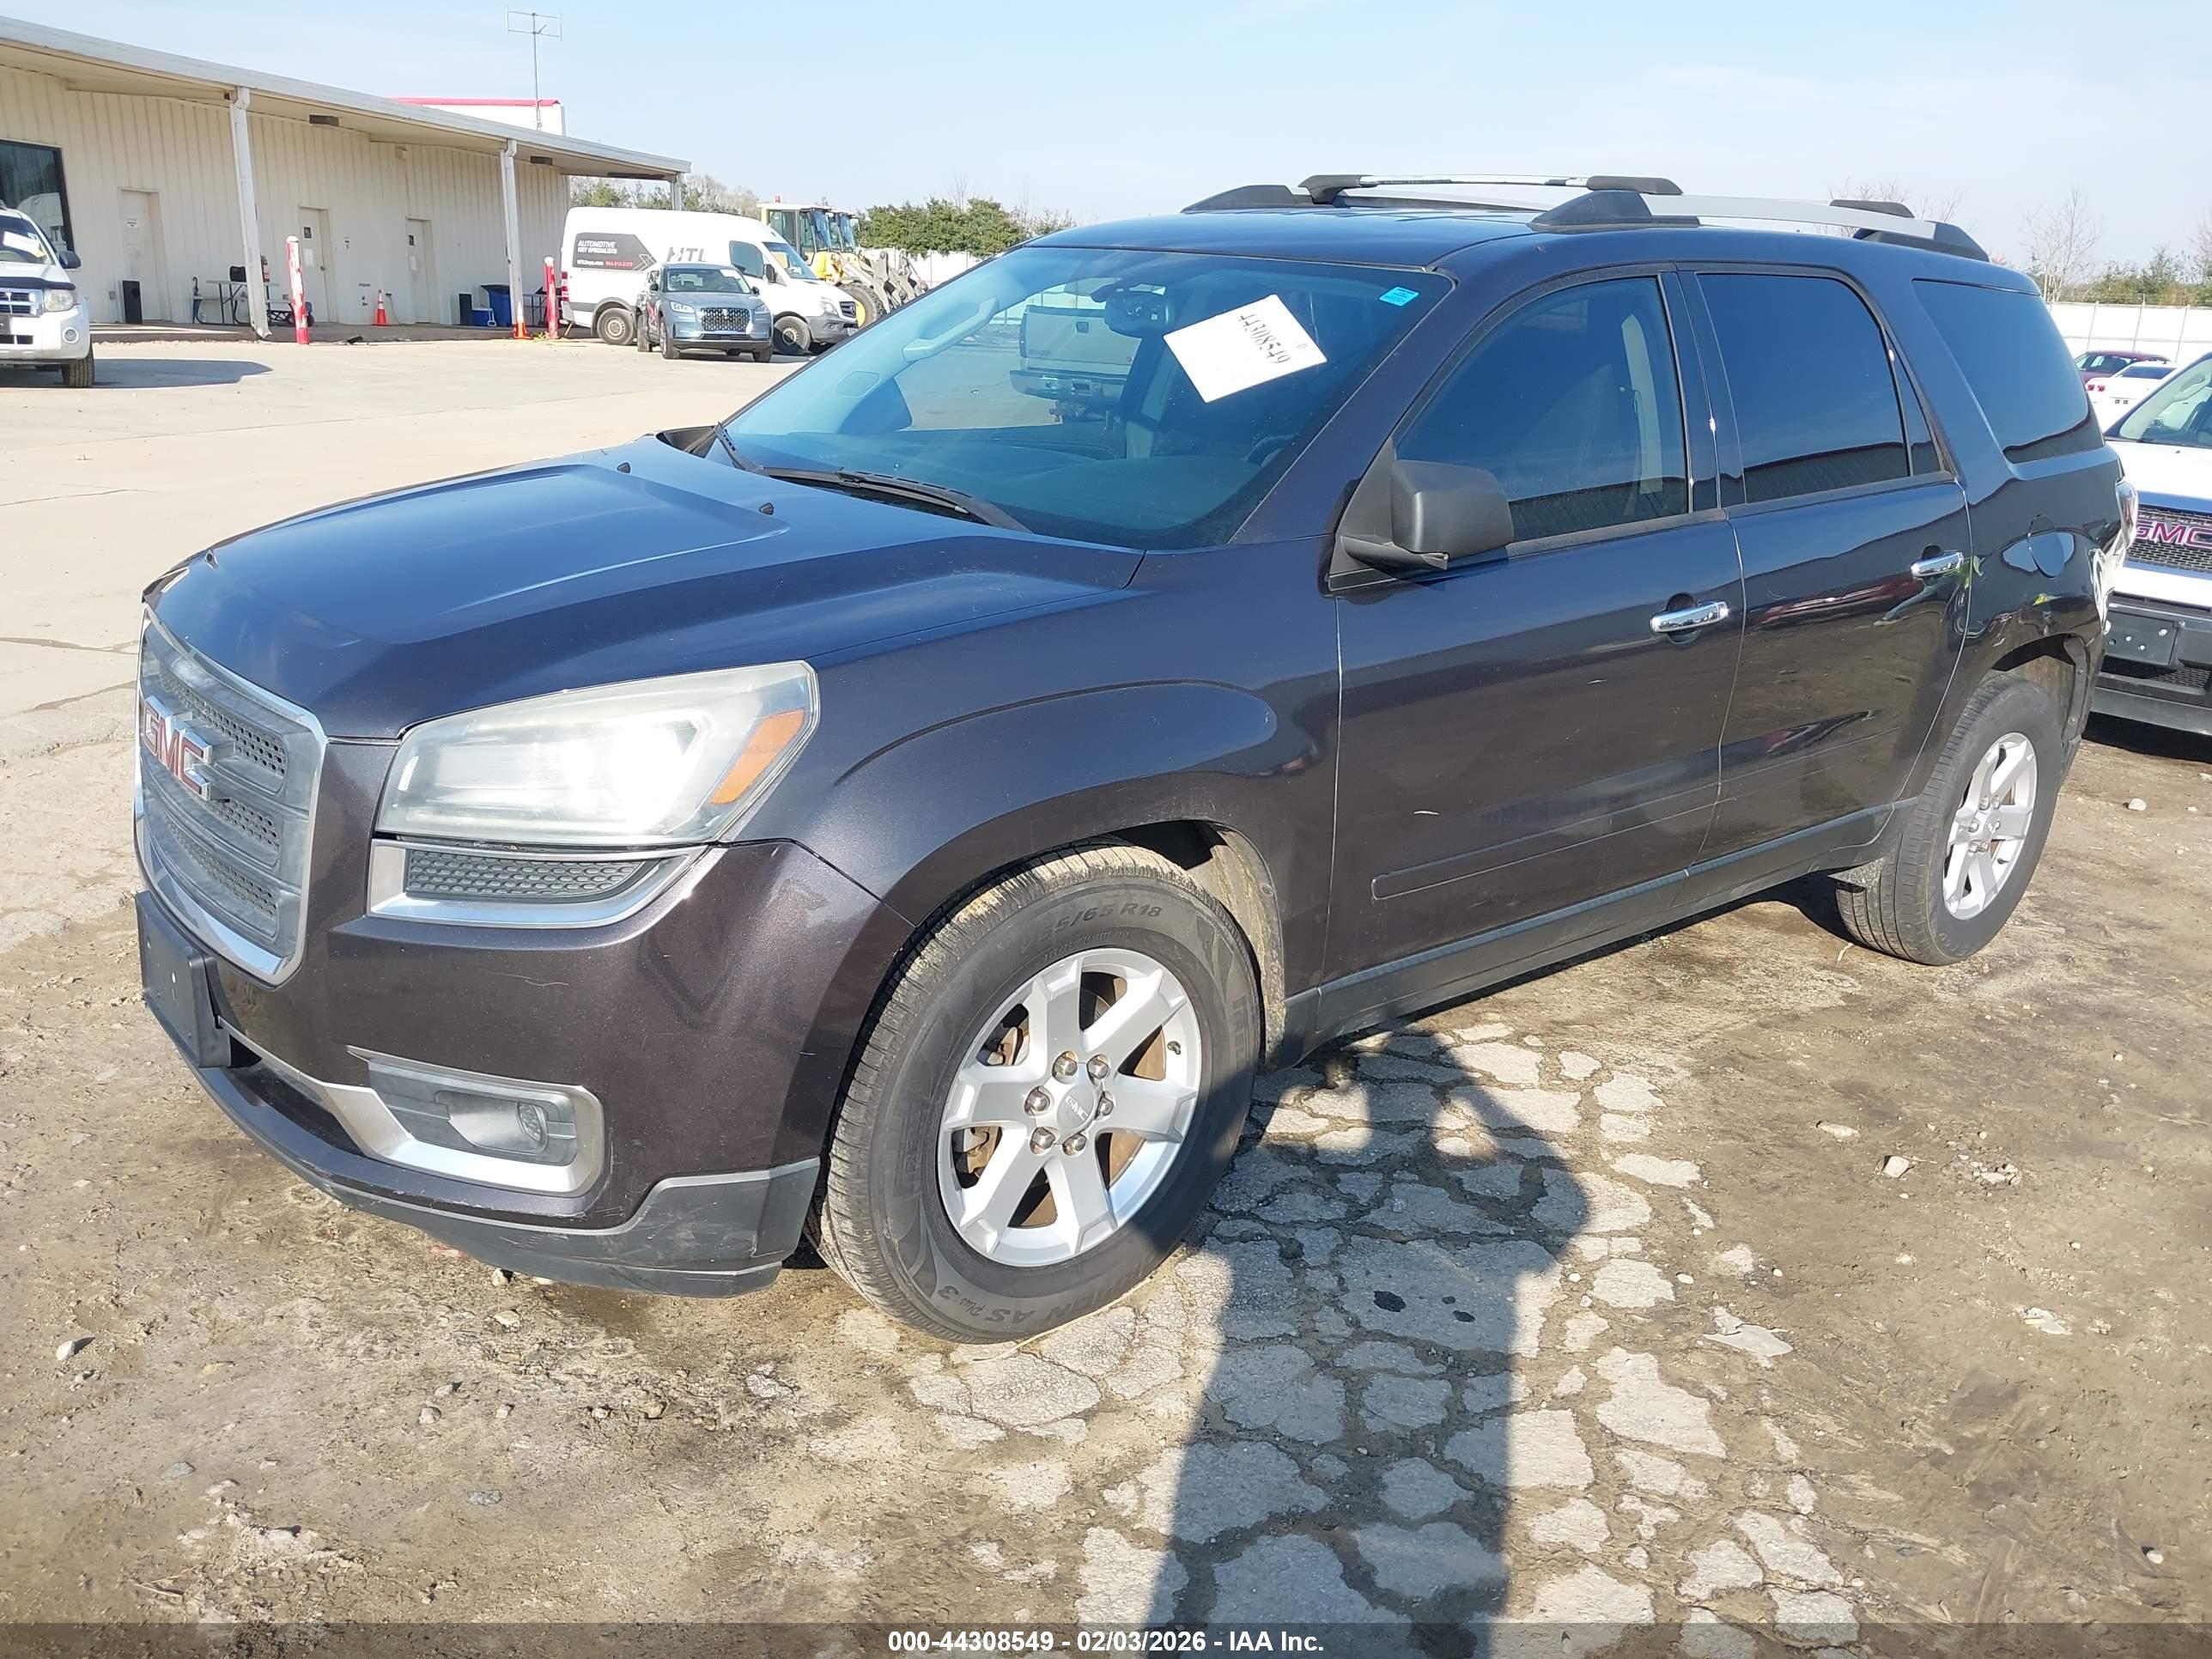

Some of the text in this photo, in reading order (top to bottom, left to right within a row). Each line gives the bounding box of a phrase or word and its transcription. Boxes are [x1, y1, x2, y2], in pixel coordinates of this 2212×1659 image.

[1237, 314, 1291, 363] 44308549
[144, 696, 212, 800] GMC
[1120, 902, 1163, 917] R18
[1065, 1096, 1088, 1121] GMC
[938, 1285, 1036, 1325] AS Plus 3
